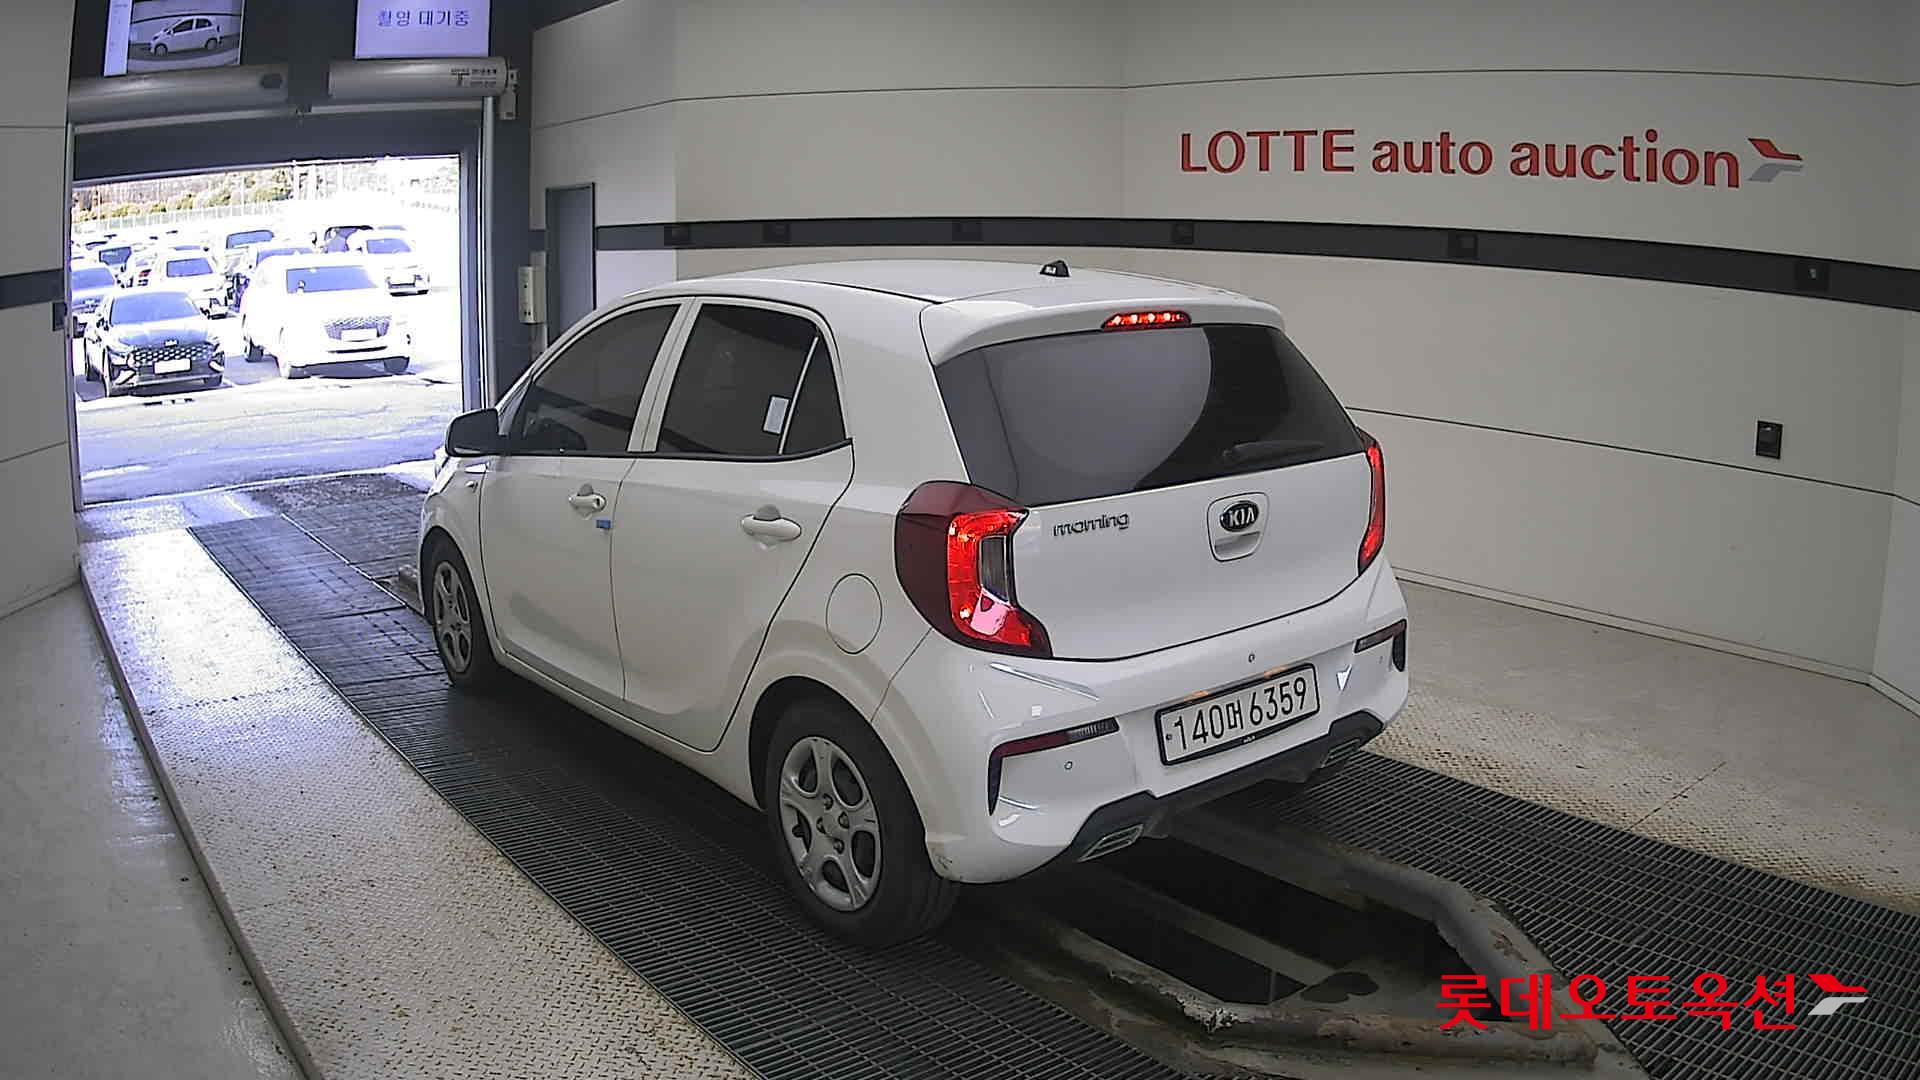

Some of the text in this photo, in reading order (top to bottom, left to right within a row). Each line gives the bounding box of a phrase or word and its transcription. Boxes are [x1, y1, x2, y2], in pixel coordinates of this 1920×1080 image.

[419, 10, 469, 27] 대기중
[1180, 129, 1740, 188] LOTTE auto auction
[1053, 513, 1130, 536] morning
[1227, 506, 1257, 528] KIA
